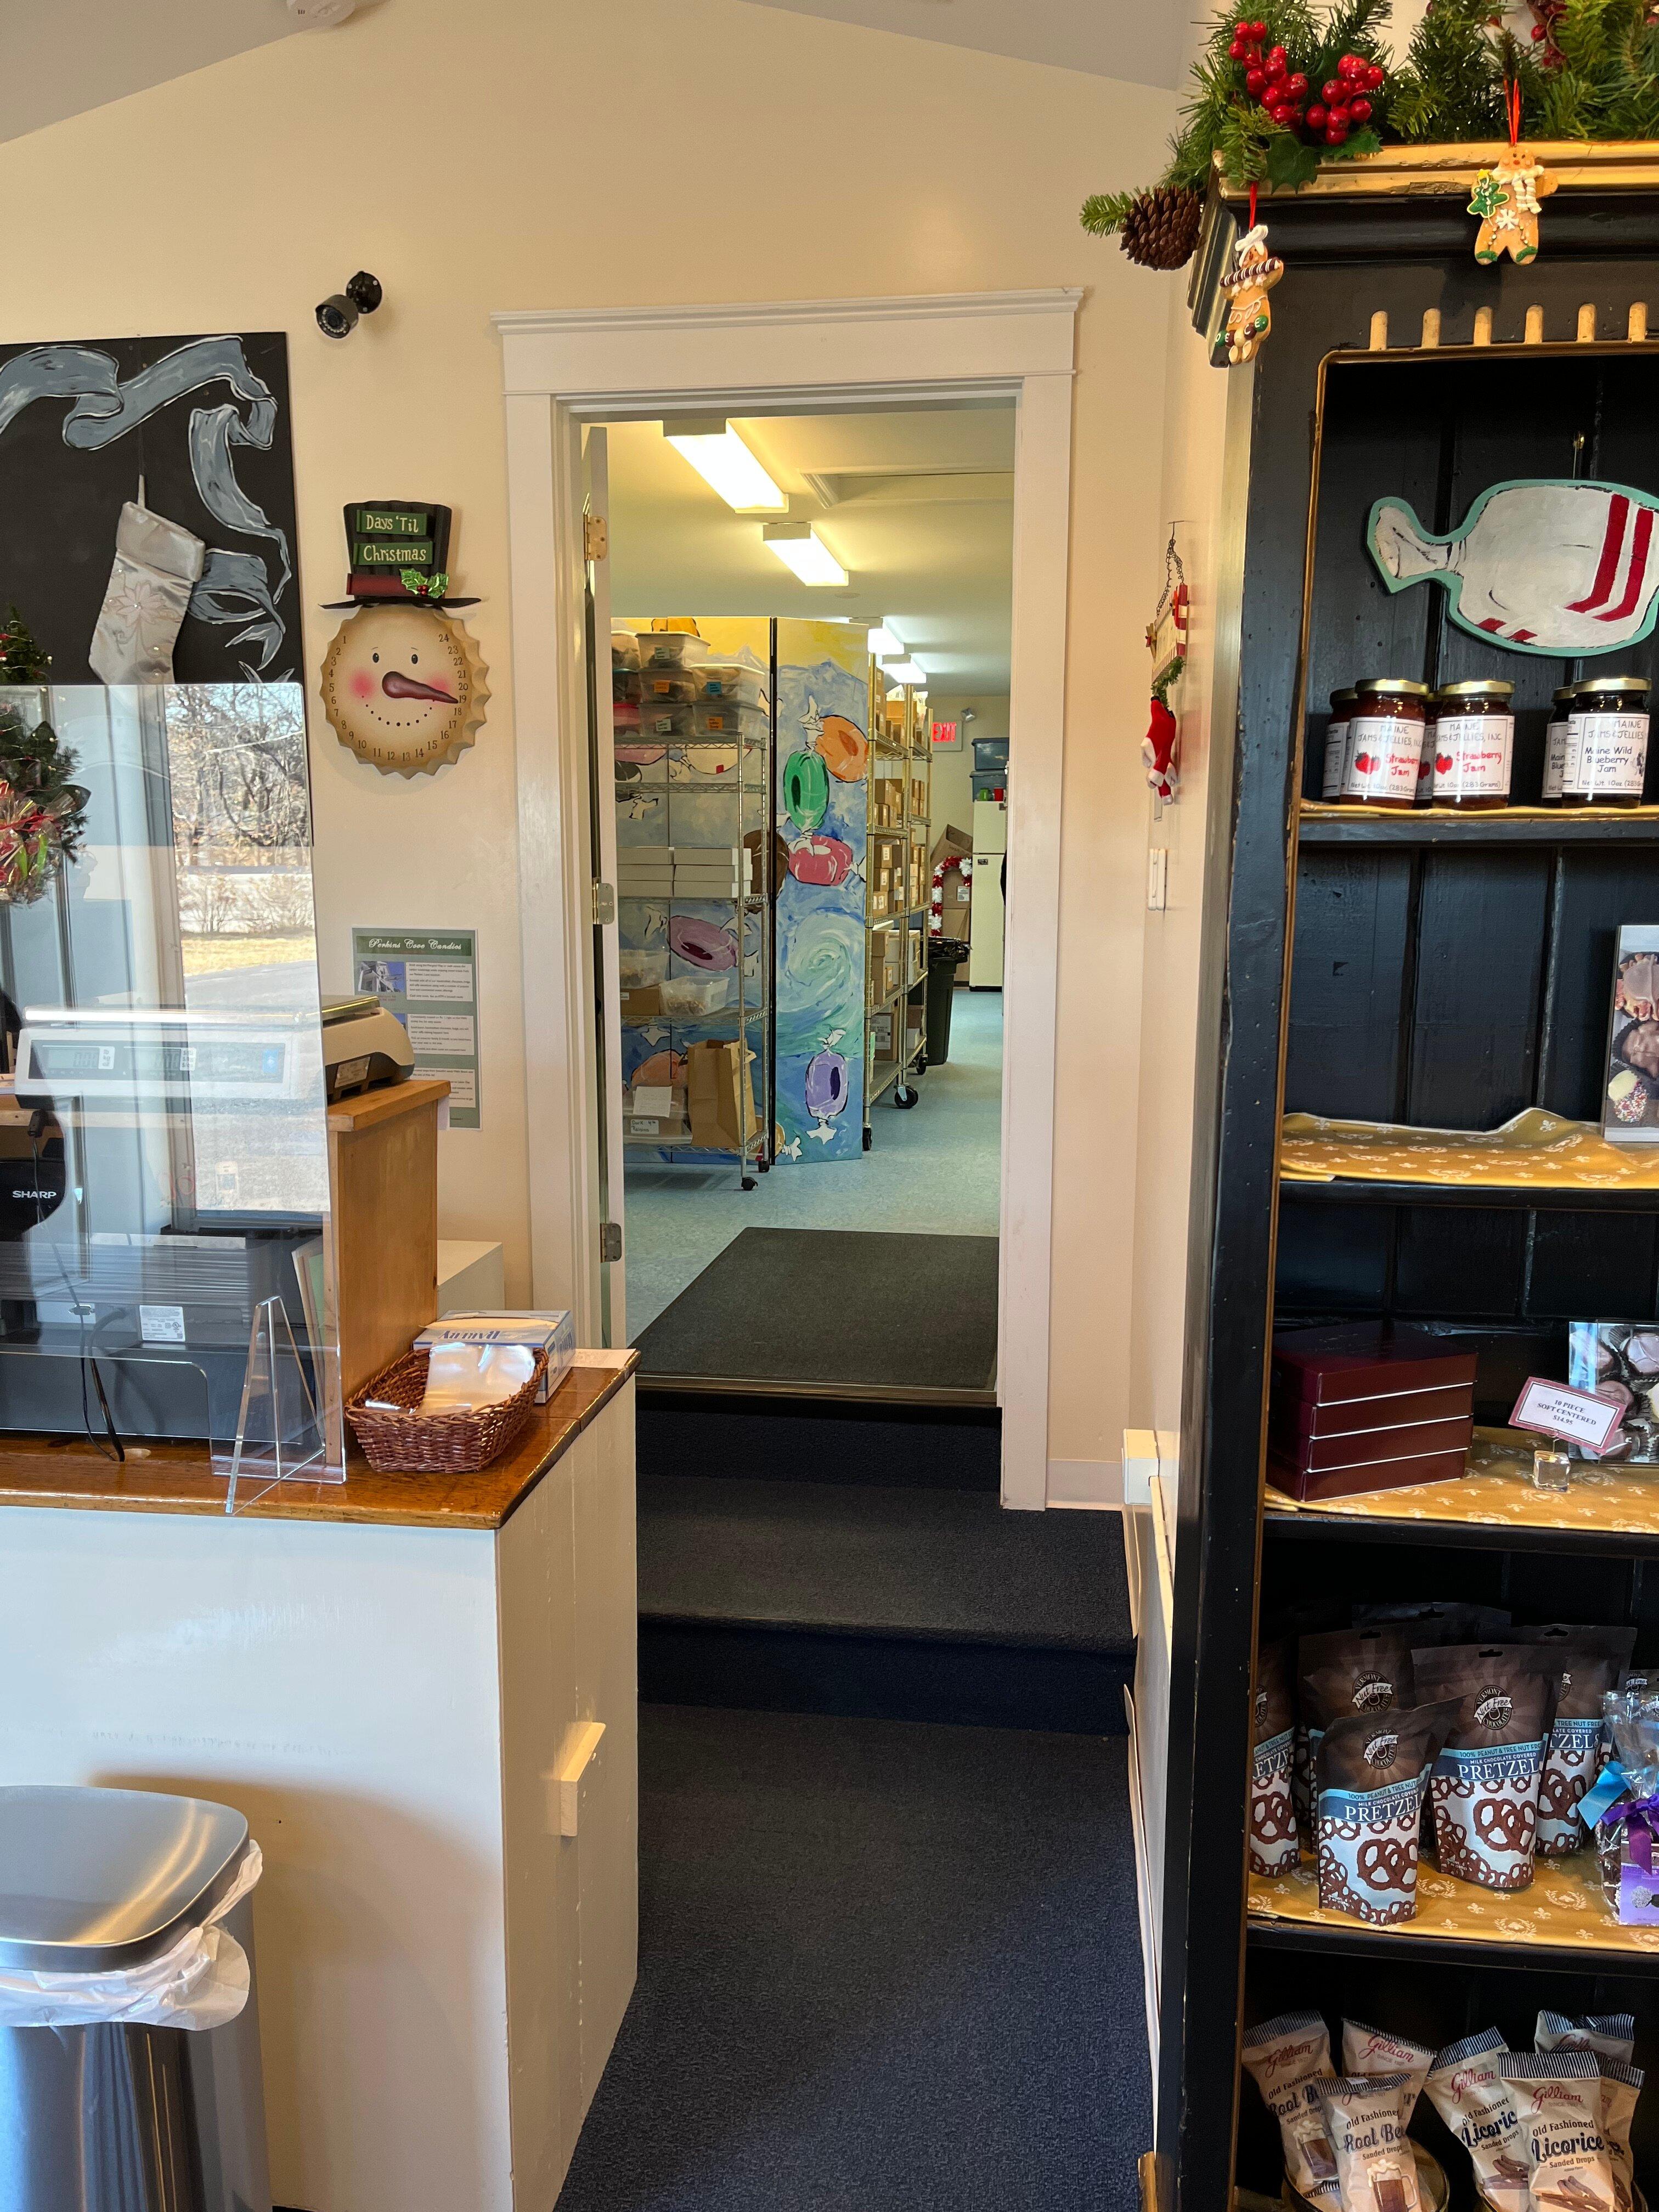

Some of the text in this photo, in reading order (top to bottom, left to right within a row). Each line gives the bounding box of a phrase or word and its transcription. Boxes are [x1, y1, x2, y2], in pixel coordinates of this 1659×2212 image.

[365, 515, 393, 530] Days
[363, 545, 427, 562] Christmas
[439, 634, 449, 642] 24
[448, 646, 459, 654] 23
[331, 657, 336, 665] 3
[453, 657, 463, 665] 22
[329, 669, 334, 677] 4
[329, 683, 334, 692] 5
[331, 696, 336, 704] 6
[459, 695, 466, 703] 19
[454, 707, 462, 716] 18
[341, 720, 347, 730] 8
[449, 720, 457, 729] 17
[1380, 725, 1409, 734] MAINE
[1450, 723, 1480, 731] MANE
[1614, 720, 1642, 729] MAINE
[349, 731, 354, 740] 9
[441, 731, 449, 739] 16
[932, 722, 956, 742] EXIT
[358, 740, 366, 749] 10
[427, 741, 437, 750] 15
[374, 748, 381, 757] 11
[415, 748, 425, 758] 14
[1613, 746, 1633, 754] Wild
[387, 751, 396, 760] 12
[403, 752, 410, 761] 13
[1455, 750, 1502, 764] Strawberry
[1587, 755, 1629, 767] Bueberry
[1391, 765, 1410, 776] Jam
[1463, 762, 1486, 772] Jam
[1598, 764, 1616, 773] Jam
[12, 1190, 57, 1199] SHARP
[1562, 1402, 1585, 1413] PIECE
[1537, 1403, 1596, 1425] SOFT CENTERED
[1552, 1415, 1574, 1425] $14.95
[1355, 1683, 1390, 1706] Nut Free
[1476, 1697, 1510, 1720] Nut Free
[1269, 1739, 1279, 1748] TREE
[1483, 1755, 1511, 1764] CHOCOLATE
[1457, 1758, 1539, 1780] PRETZEL
[1367, 1790, 1387, 1799] PEANUT
[1405, 1781, 1417, 1790] NUT
[1373, 1795, 1400, 1805] CHOCOLATE
[1344, 1793, 1421, 1822] PRETZEL
[1358, 2034, 1414, 2063] Gilliam
[1268, 2085, 1281, 2100] Old
[1283, 2068, 1323, 2090] Fashioned
[1451, 2068, 1497, 2104] Gilliam
[1530, 2086, 1584, 2114] Gilliam
[1286, 2106, 1323, 2125] Sanded Drop
[1462, 2111, 1473, 2126] Old
[1346, 2116, 1360, 2130] Old
[1461, 2110, 1519, 2148] Licoric
[1532, 2120, 1594, 2137] Old Fashioned
[1344, 2126, 1380, 2154] Root
[1481, 2129, 1519, 2151] Sanded Drops
[1531, 2131, 1605, 2164] Licorice
[1362, 2145, 1403, 2161] Sanded Drop
[1549, 2159, 1575, 2169] Sanded
[1576, 2156, 1595, 2165] Drops
